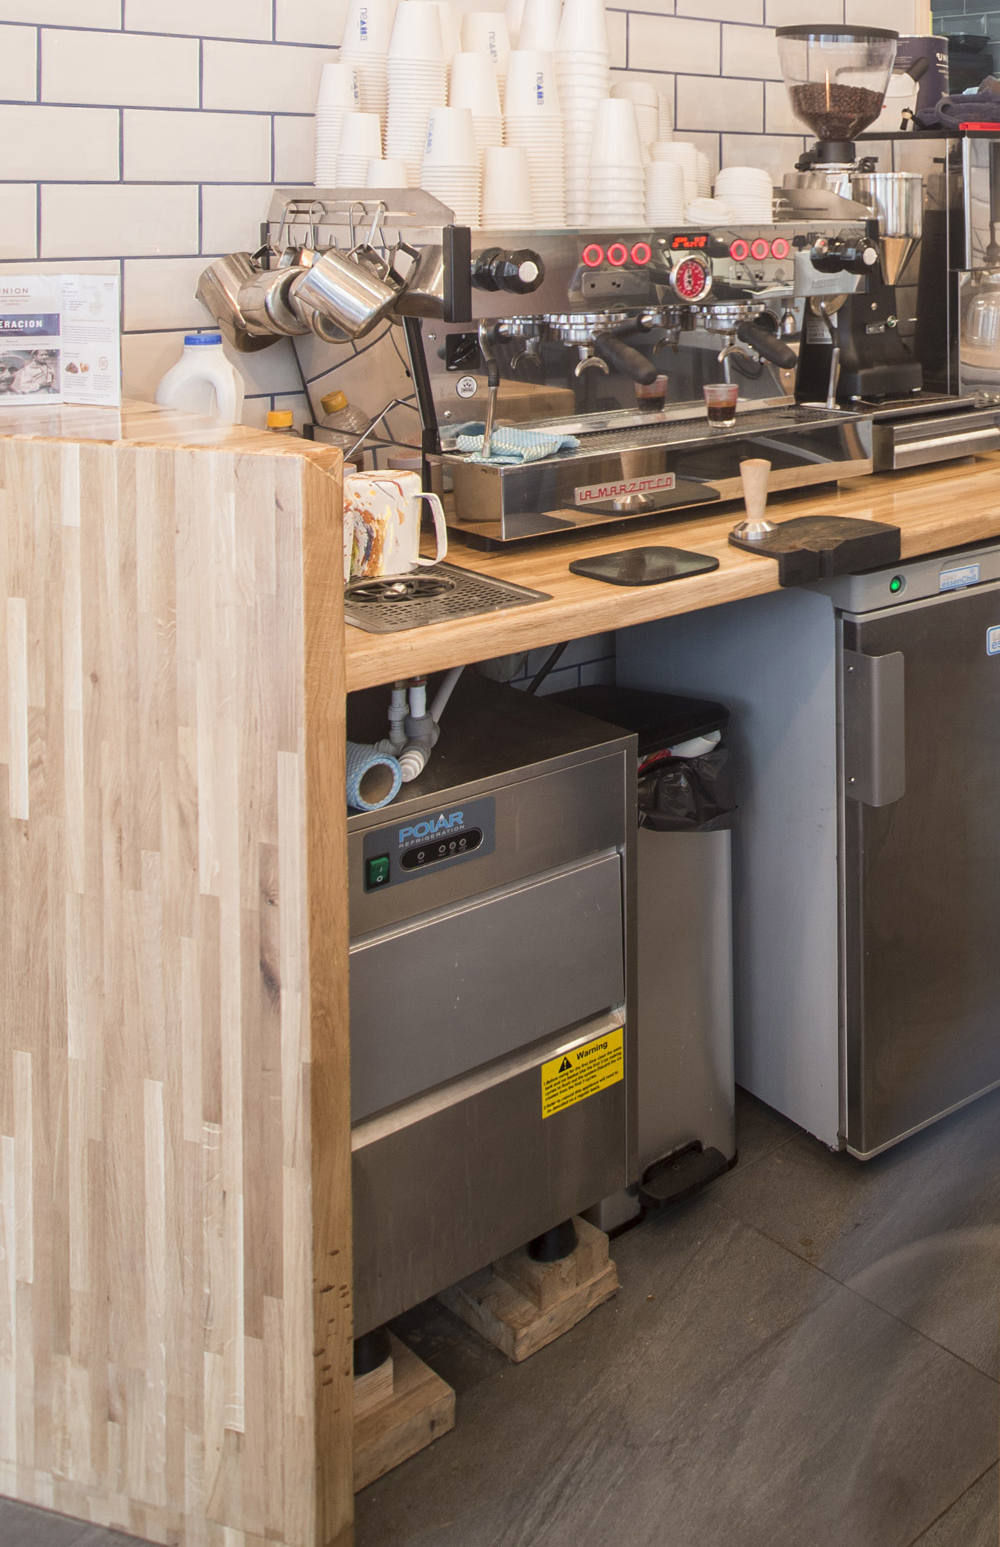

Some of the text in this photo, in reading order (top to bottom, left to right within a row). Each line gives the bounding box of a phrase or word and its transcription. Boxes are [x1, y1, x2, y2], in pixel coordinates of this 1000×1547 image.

[580, 489, 592, 501] LA
[399, 811, 464, 843] POLAR
[399, 824, 465, 849] REFRIGERATION
[576, 1042, 608, 1060] Warning
